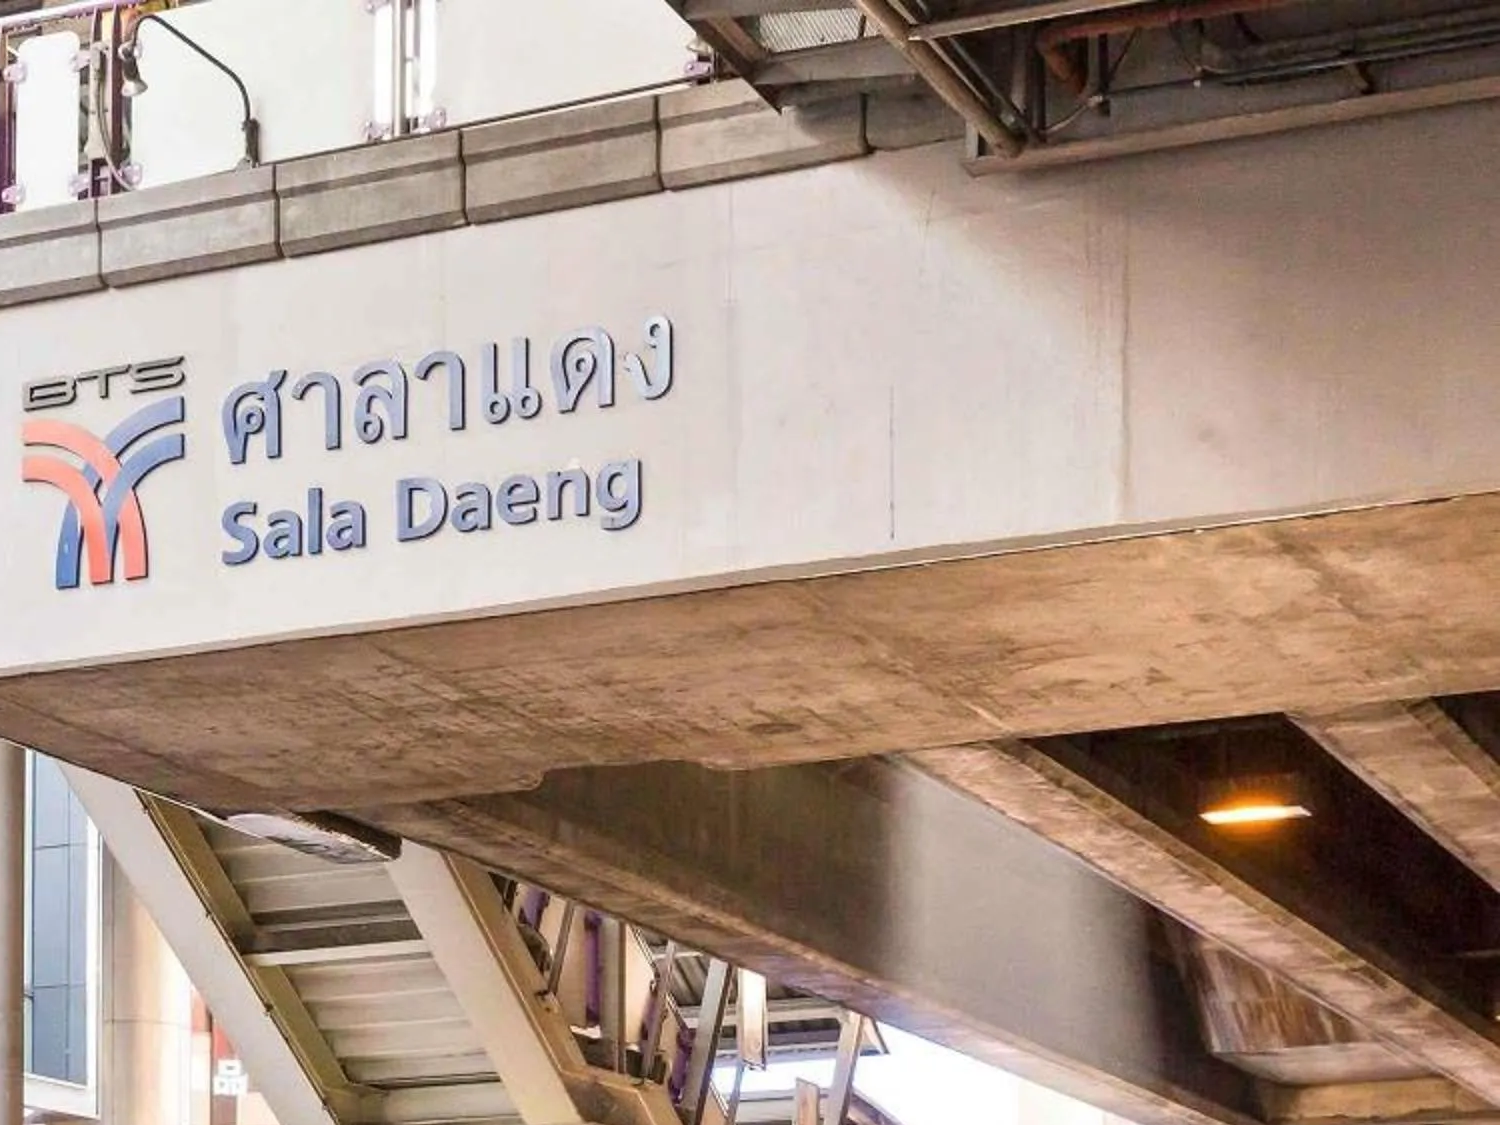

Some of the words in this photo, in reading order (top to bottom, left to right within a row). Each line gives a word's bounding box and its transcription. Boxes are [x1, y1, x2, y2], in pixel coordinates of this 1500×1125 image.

[23, 355, 186, 412] BTS
[221, 314, 674, 464] ศาลาแดง
[221, 487, 367, 567] Sala
[398, 458, 643, 543] Daeng
